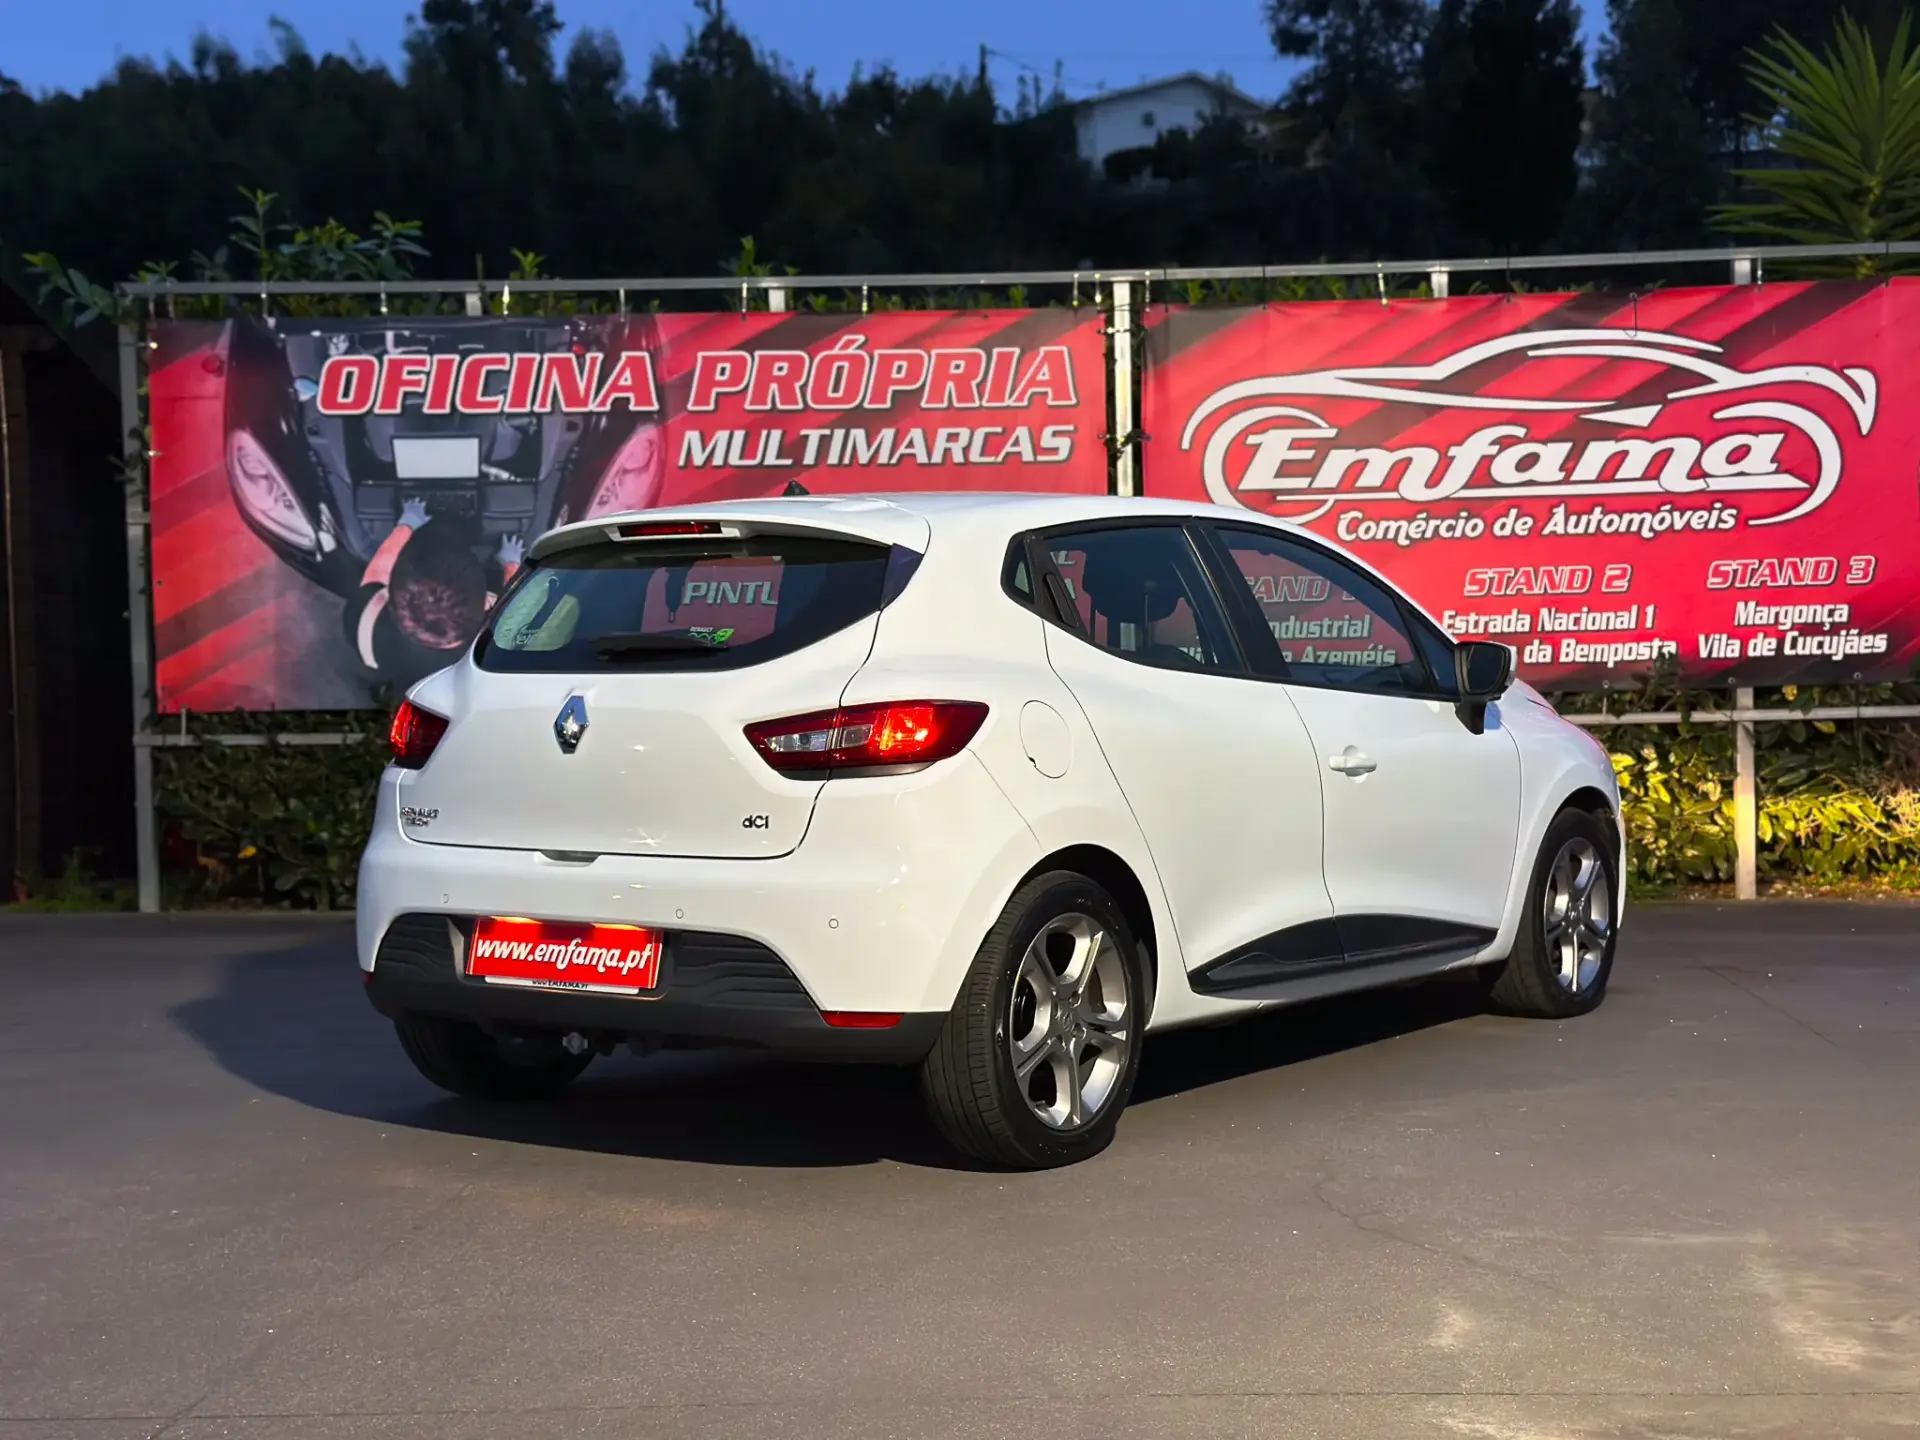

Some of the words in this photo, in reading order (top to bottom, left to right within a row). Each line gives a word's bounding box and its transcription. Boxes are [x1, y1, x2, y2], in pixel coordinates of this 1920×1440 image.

[316, 352, 660, 416] OFICINA
[686, 334, 1078, 411] PRÓPRIA
[678, 425, 1075, 468] MULTIMARCAS
[1237, 424, 1787, 501] Emfama
[1336, 510, 1484, 546] Comércio
[1492, 508, 1530, 537] de
[1541, 502, 1738, 539] Automóveis
[1463, 565, 1593, 597] STAND
[1601, 563, 1632, 593] 2
[1707, 556, 1838, 589] STAND
[1846, 555, 1876, 584] 3
[1442, 608, 1531, 635] Estrada
[1537, 604, 1639, 633] Nacional
[1645, 604, 1656, 629] 1
[1734, 600, 1850, 631] Margonça
[1523, 639, 1553, 664] da
[1698, 633, 1741, 659] Vila
[1747, 632, 1778, 657] de
[1783, 628, 1889, 661] Cucujães
[477, 938, 653, 975] www.emfama.pt
